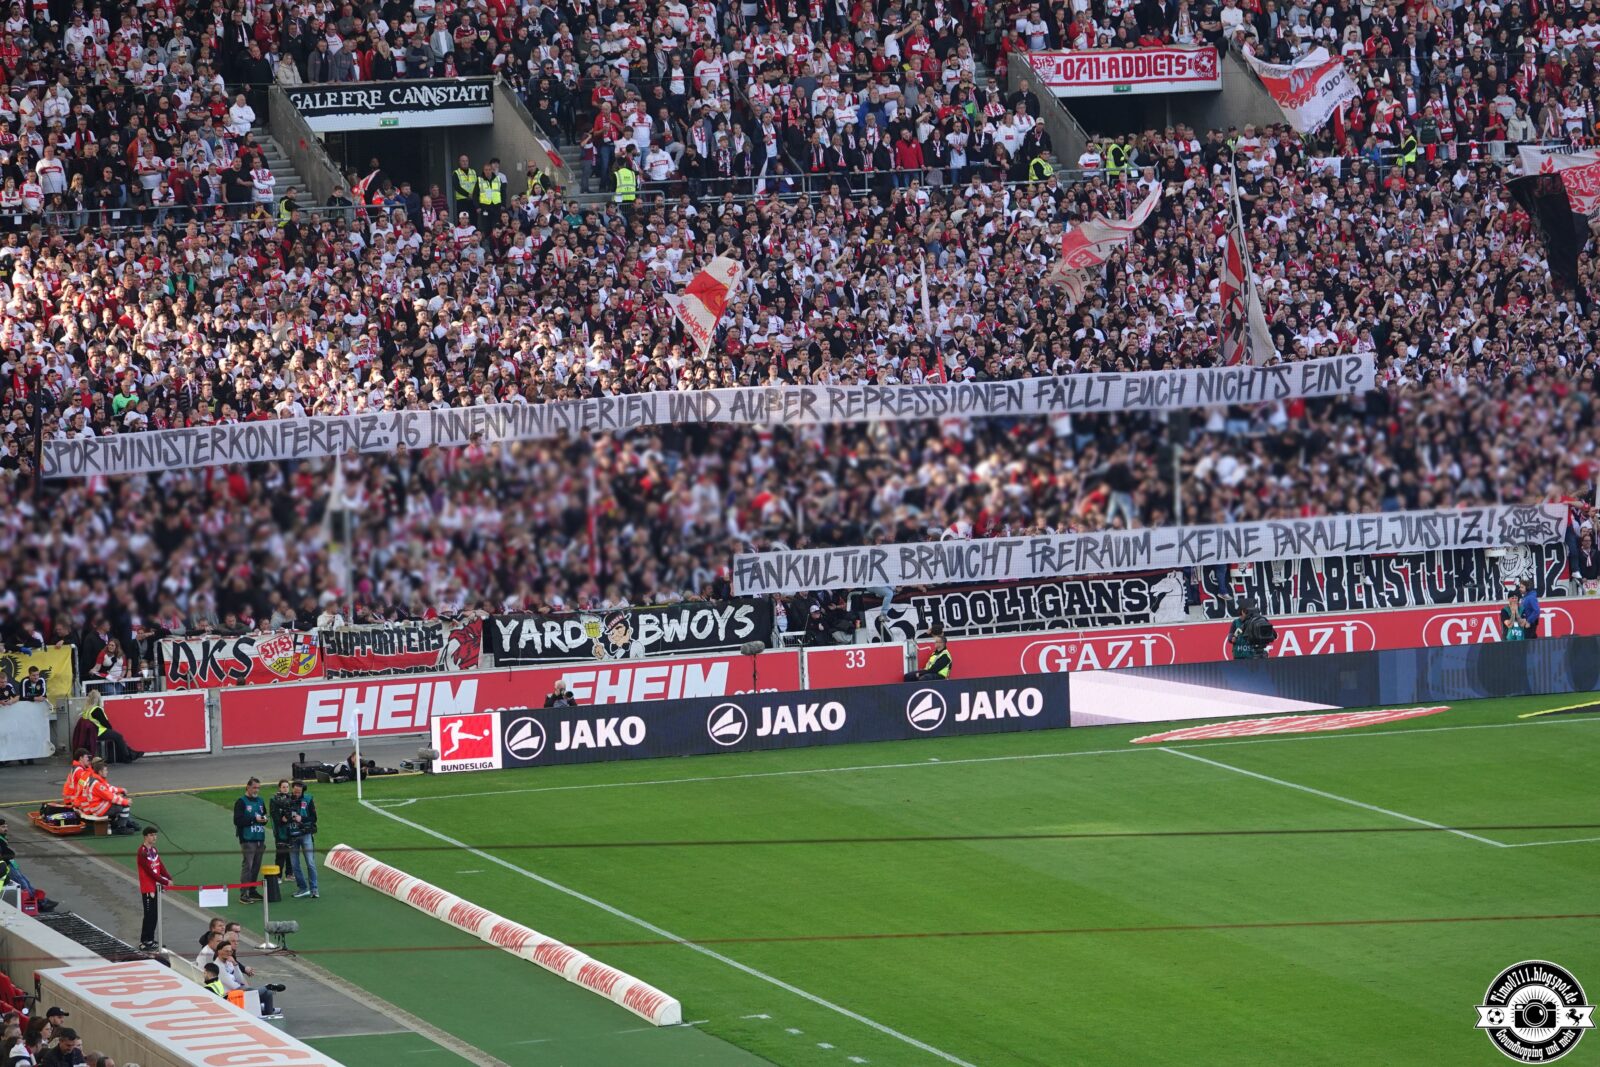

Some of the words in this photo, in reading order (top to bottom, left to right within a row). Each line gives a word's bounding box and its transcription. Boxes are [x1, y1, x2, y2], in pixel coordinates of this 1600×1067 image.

[1062, 57, 1101, 80] 0711
[290, 90, 386, 109] GALEERE
[389, 85, 490, 106] CANNSTATT
[431, 393, 657, 443] INNENMINISTERIEN
[669, 390, 721, 423] UND
[826, 382, 1024, 420] REPRESSIONEN
[1122, 374, 1187, 406] EUCH
[1196, 366, 1292, 403] NICHTS
[735, 548, 889, 591] FANKULTUR
[899, 540, 1023, 580] BRAUCHT
[1273, 509, 1496, 557] PARALLELJUSTIZ!
[912, 578, 1151, 630] HOOLIGANS
[324, 622, 444, 657] SUPPORTERS
[497, 617, 589, 653] YARD
[638, 604, 756, 645] BWOYS
[845, 651, 866, 668] 33
[143, 698, 165, 718] 32
[302, 679, 479, 735] EHEIM
[756, 701, 847, 737] JAKO
[954, 687, 1043, 722] JAKO
[554, 716, 646, 751] JAKO
[441, 762, 494, 771] BUNDESLIGA
